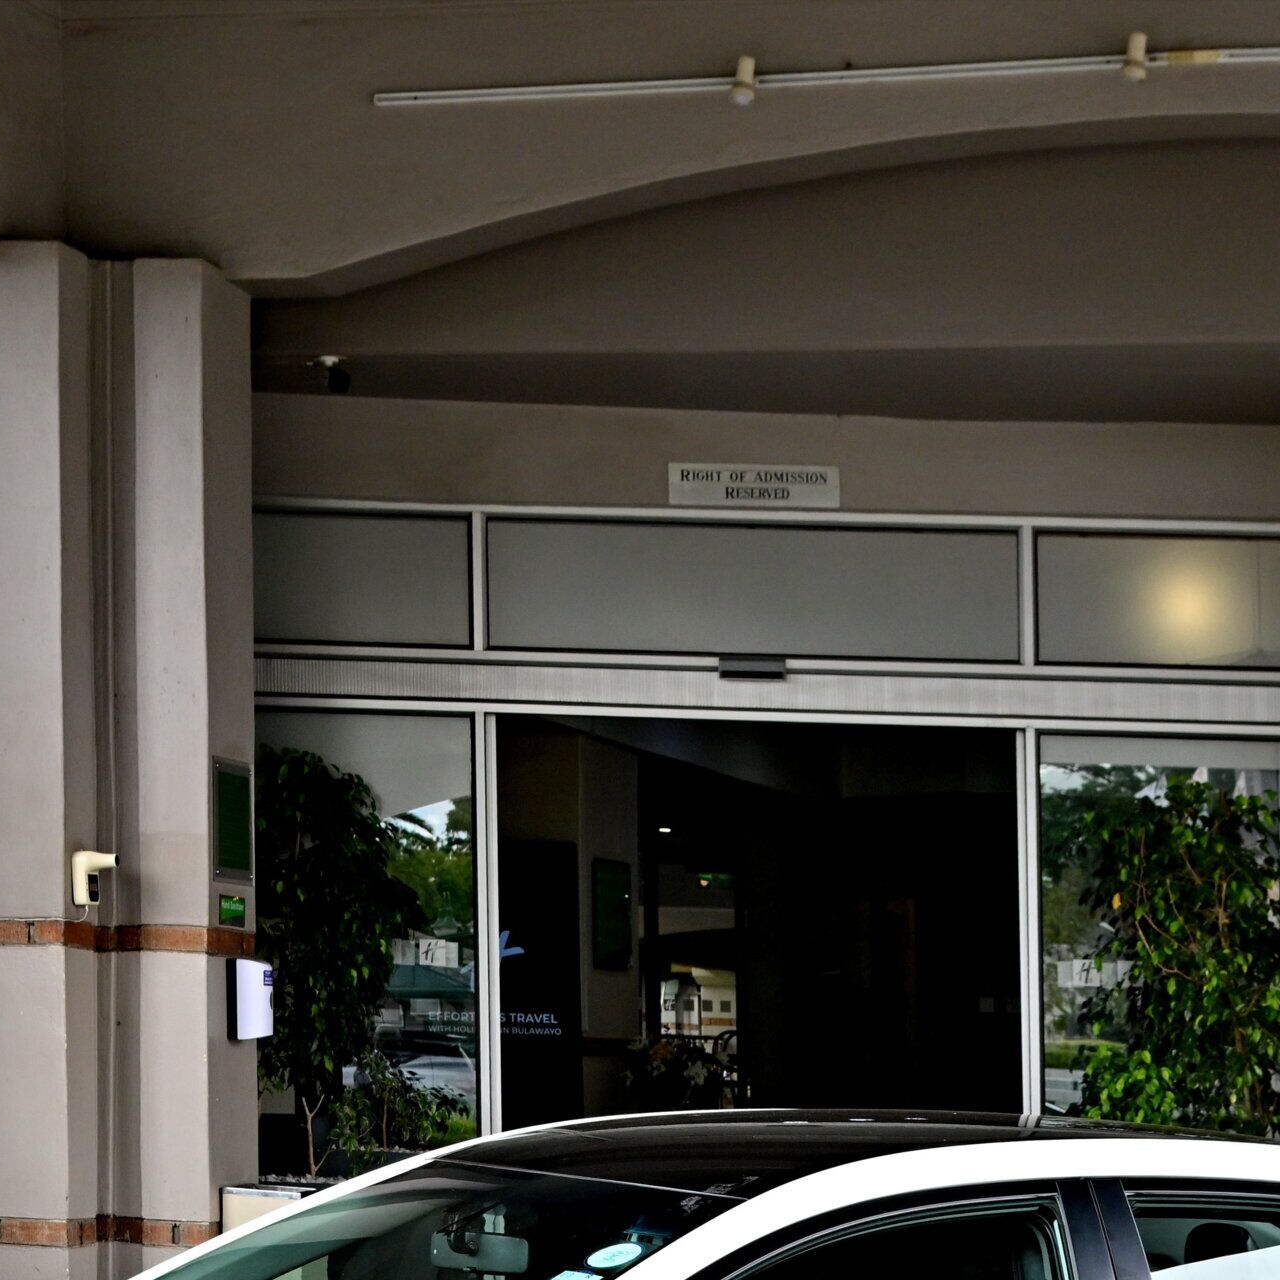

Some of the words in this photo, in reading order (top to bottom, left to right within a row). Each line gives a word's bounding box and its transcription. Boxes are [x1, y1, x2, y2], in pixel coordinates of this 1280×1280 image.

[680, 468, 721, 482] RIGHT
[730, 470, 746, 483] OF
[755, 471, 828, 485] ADMISSION
[725, 486, 790, 500] RESERVED
[509, 1013, 558, 1024] TRAVEL
[428, 1024, 451, 1033] WITH
[512, 1026, 562, 1036] BULAWAYO
